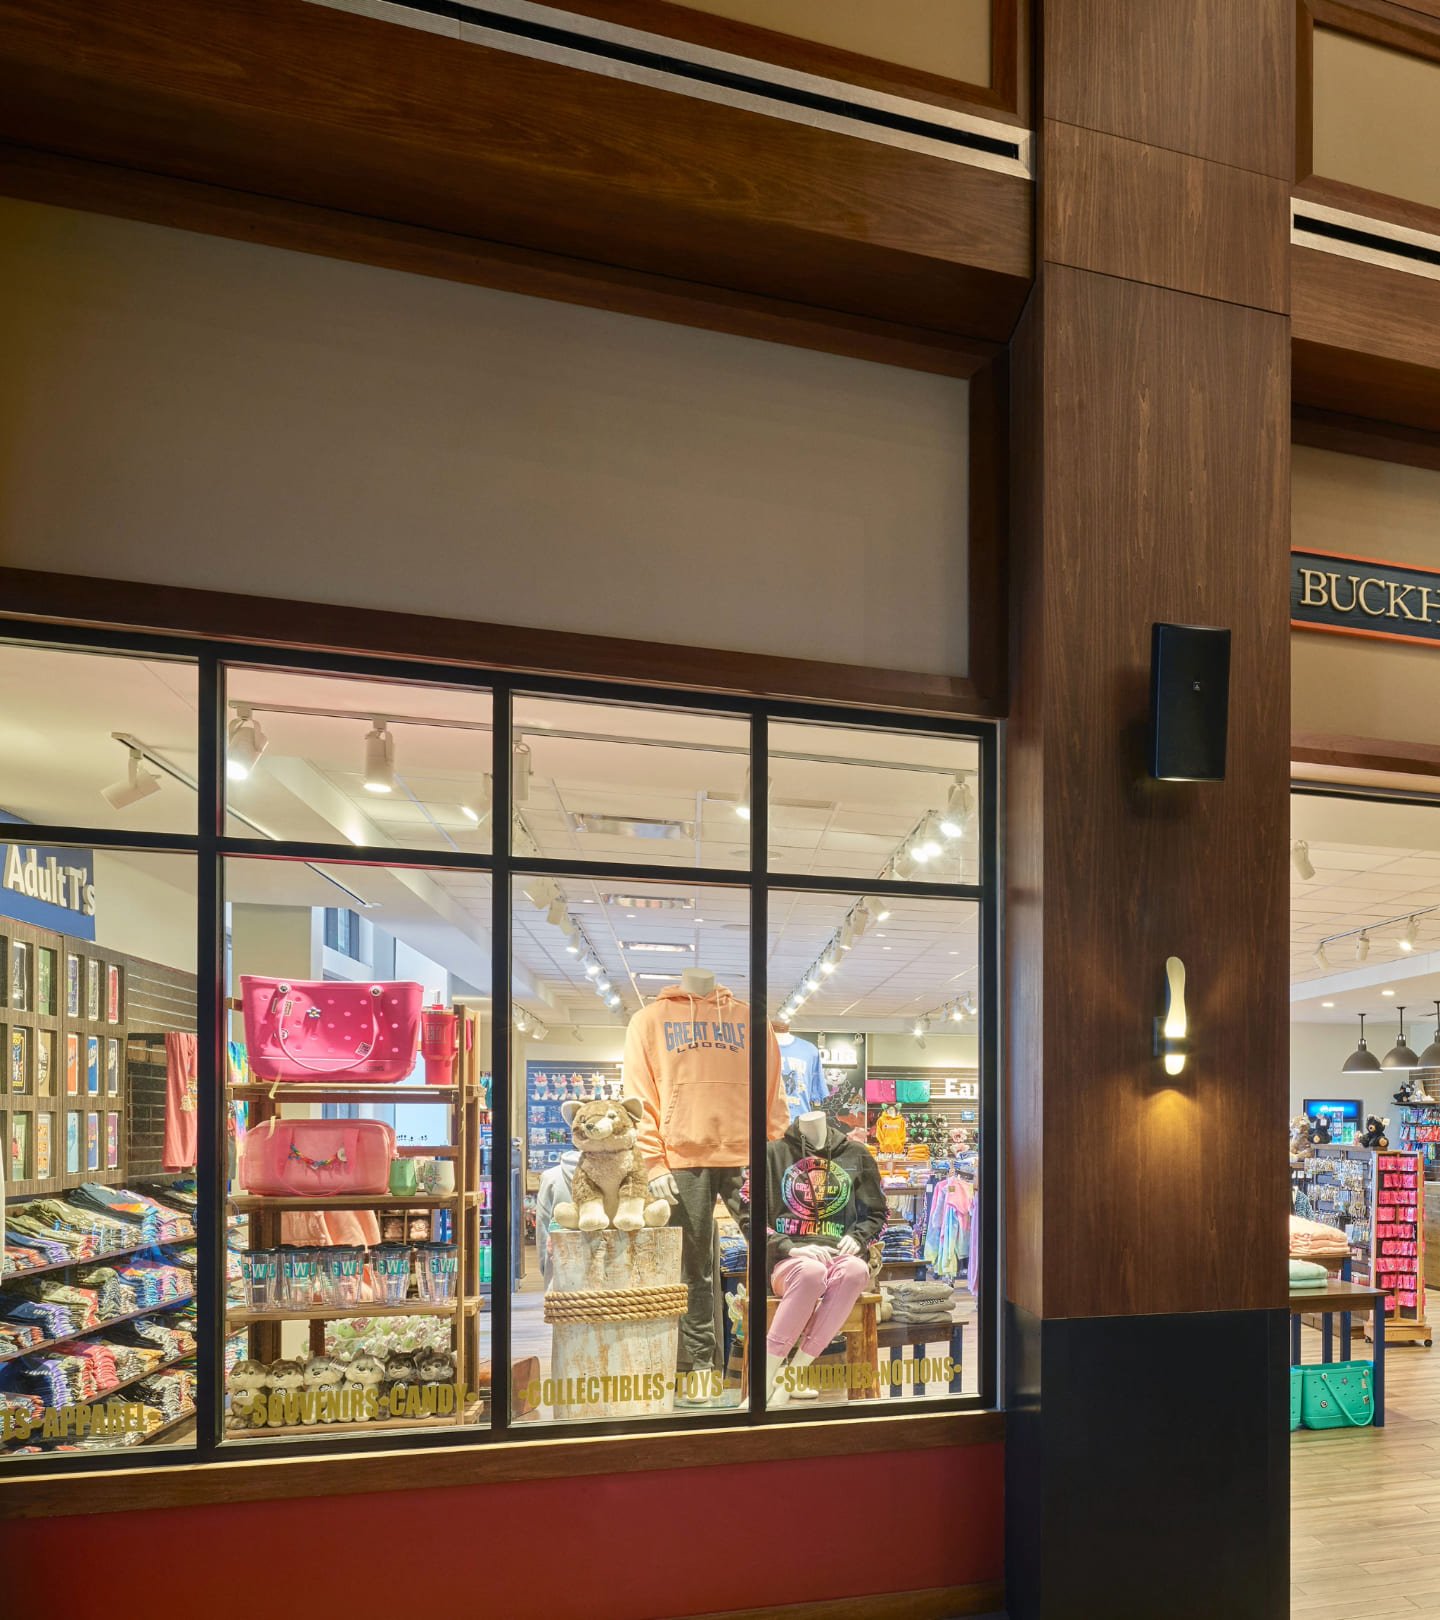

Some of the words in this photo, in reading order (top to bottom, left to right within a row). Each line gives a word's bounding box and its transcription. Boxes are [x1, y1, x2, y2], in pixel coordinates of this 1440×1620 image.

[3, 844, 67, 907] Adult
[663, 1021, 708, 1052] GREAT
[676, 1041, 739, 1054] LODGE
[775, 1217, 800, 1235] GREAT
[528, 1373, 665, 1408] COLLECTIBLES
[675, 1370, 724, 1399] TOYS
[784, 1362, 874, 1392] SUNDRIES
[880, 1357, 955, 1386] NOTIONS
[42, 1402, 148, 1438] APPAREL
[252, 1388, 379, 1425] SOUVENIRS
[391, 1383, 468, 1415] CANDY
